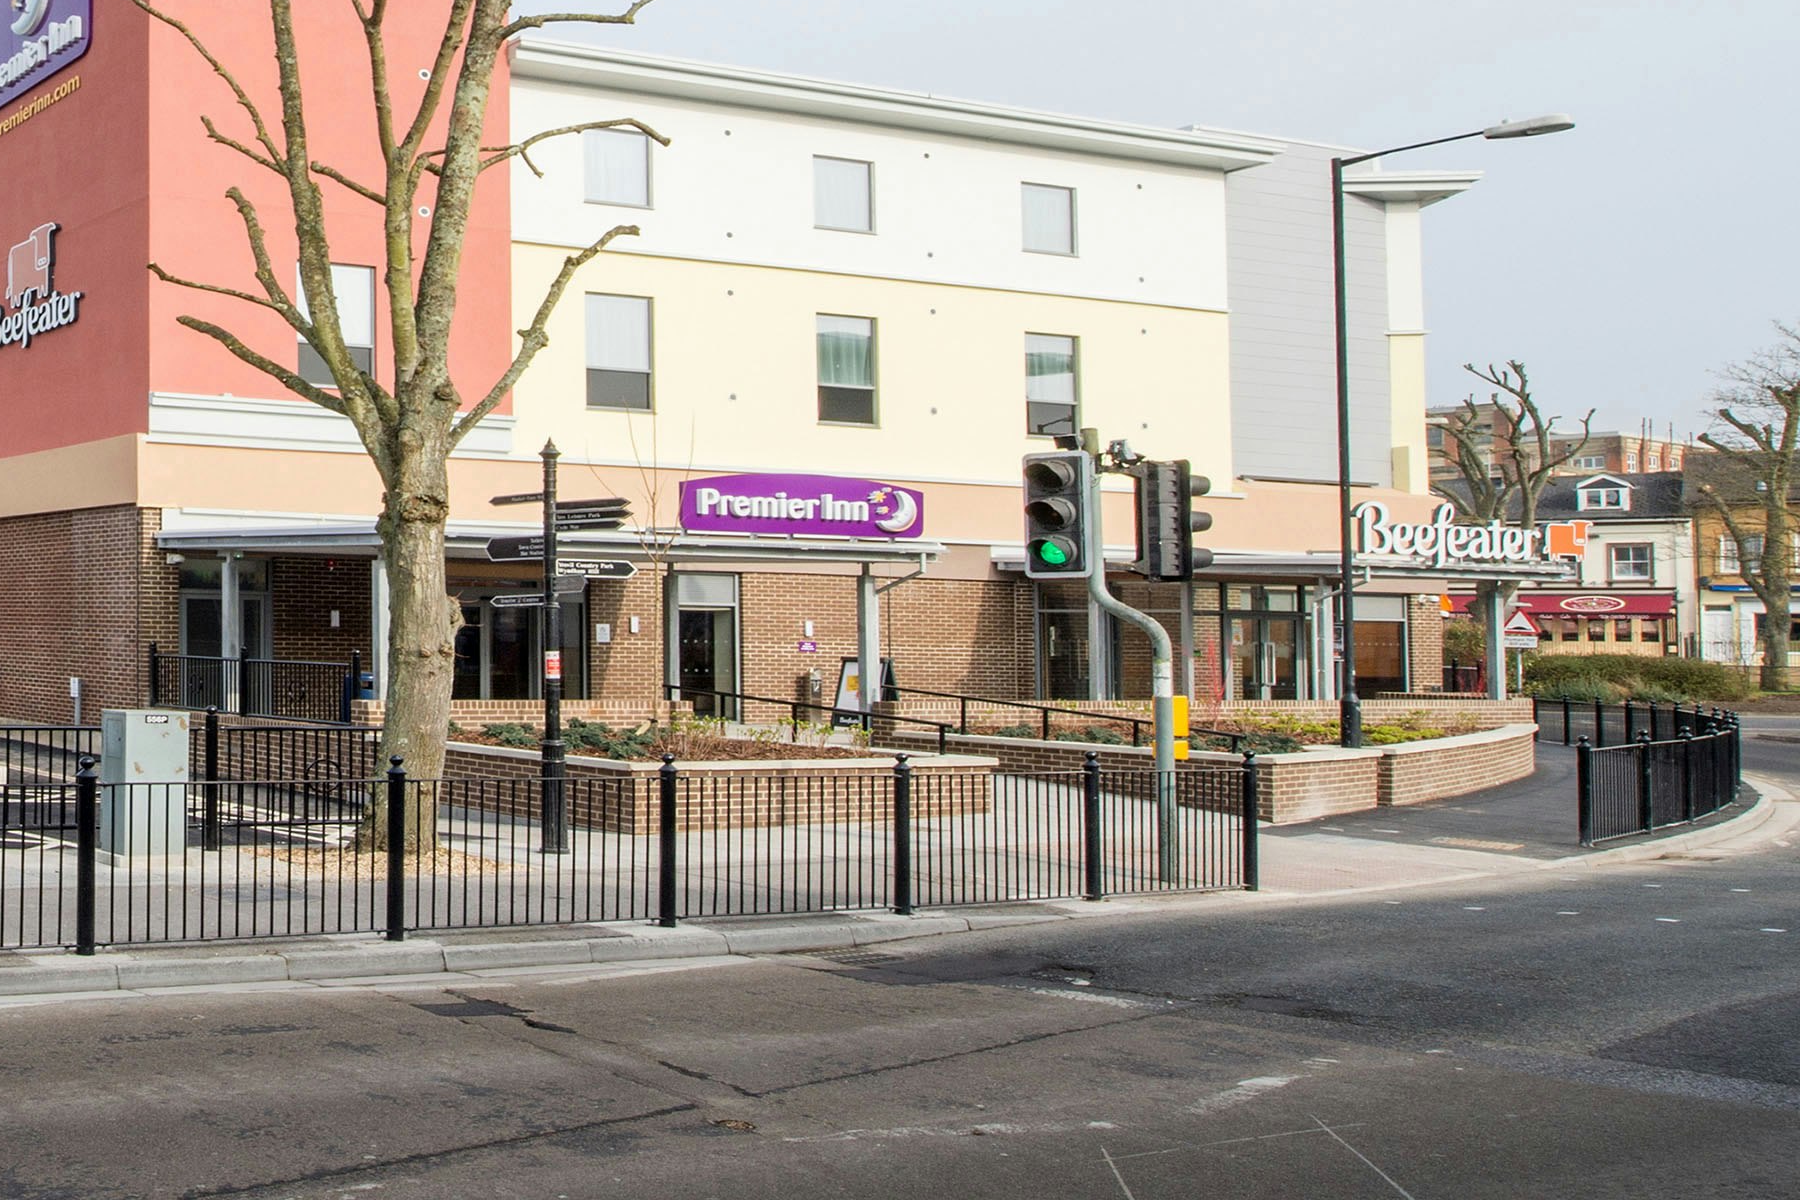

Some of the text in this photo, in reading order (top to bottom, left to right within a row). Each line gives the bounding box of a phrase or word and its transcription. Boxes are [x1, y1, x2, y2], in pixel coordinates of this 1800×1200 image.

[48, 15, 82, 55] Inn
[695, 487, 869, 521] Premier Inn
[1354, 500, 1542, 568] Beefeater
